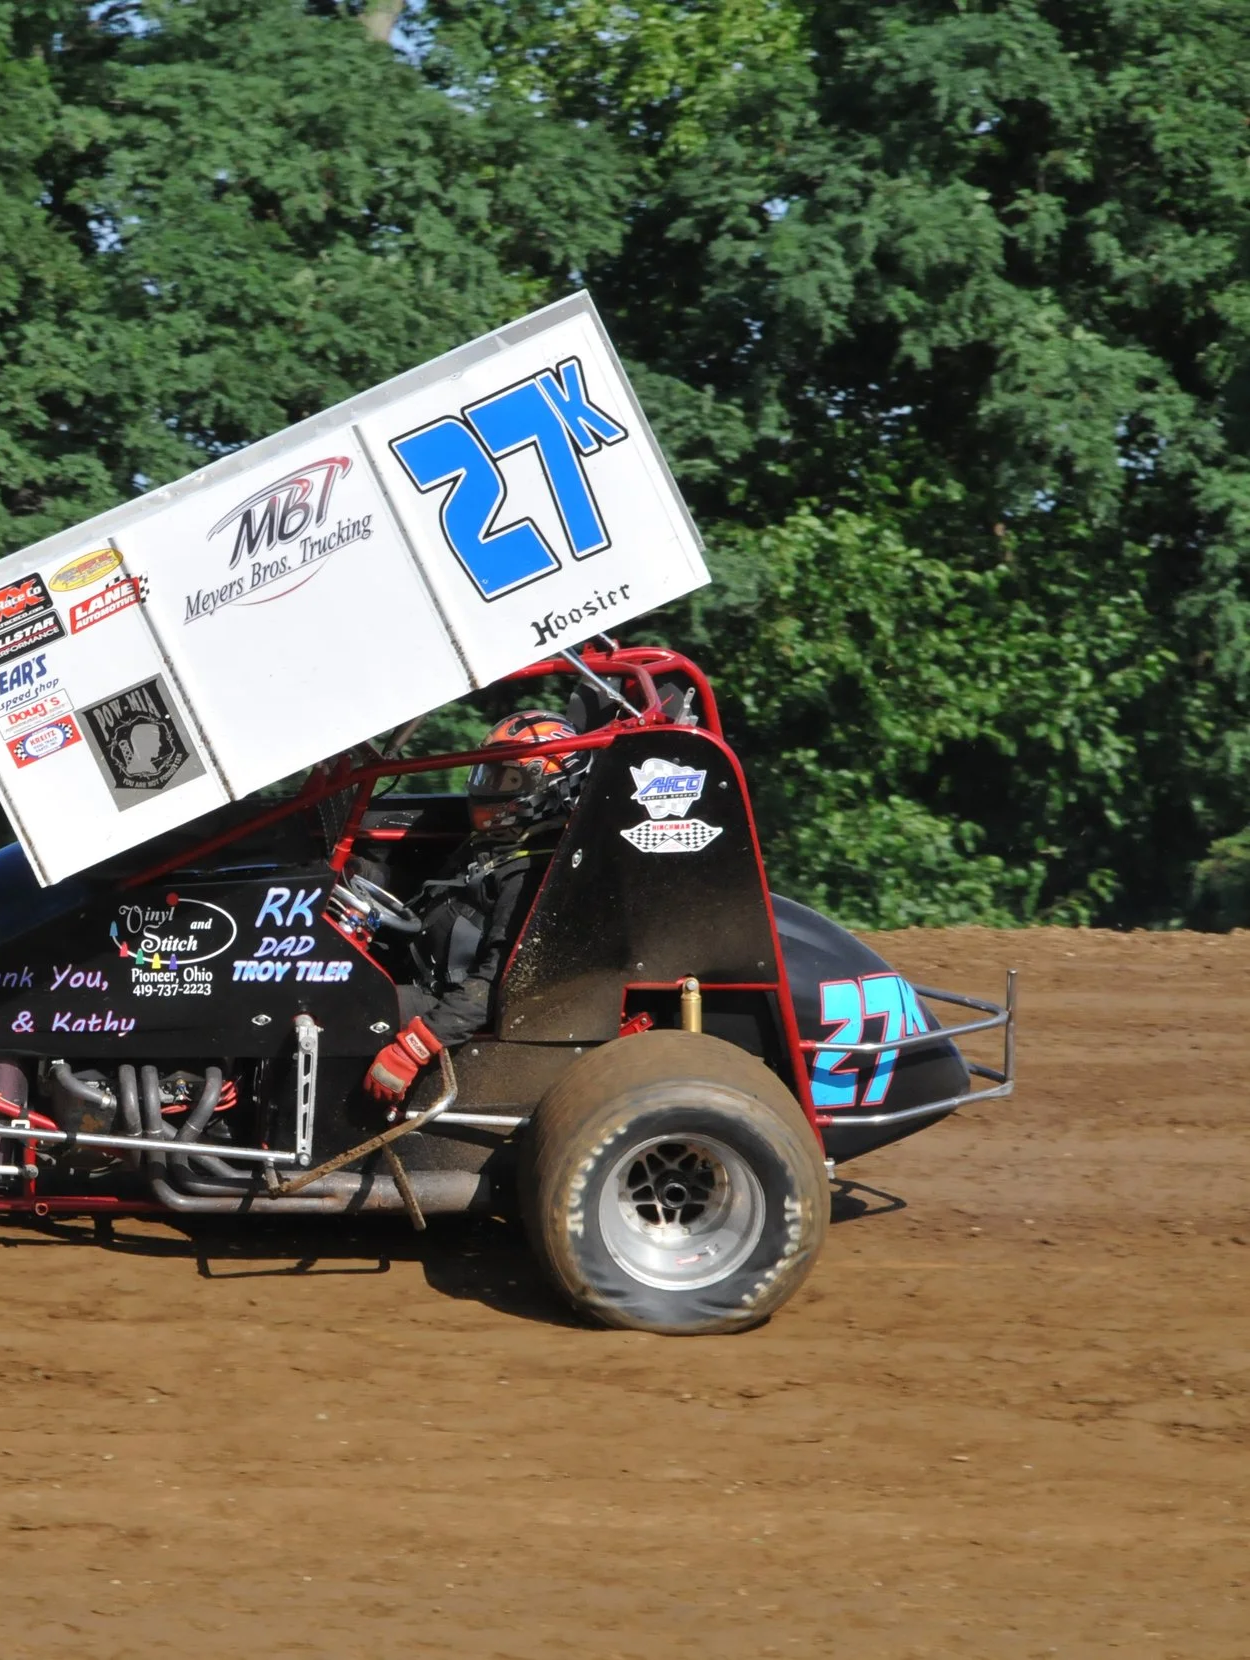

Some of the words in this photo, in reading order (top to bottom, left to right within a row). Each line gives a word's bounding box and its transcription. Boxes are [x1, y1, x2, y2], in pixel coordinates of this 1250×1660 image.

[388, 355, 629, 603] 27K
[229, 456, 353, 569] MBT
[184, 576, 244, 621] Meyers
[250, 555, 292, 588] Bros.
[300, 514, 372, 563] Trucking
[26, 586, 42, 597] Co
[75, 581, 136, 621] LANE
[76, 595, 137, 629] AUTOMOTIVE
[530, 583, 631, 648] Hoosier
[0, 689, 31, 711] speed
[34, 678, 59, 698] shop
[7, 697, 60, 724] Doug's
[118, 904, 175, 934] Vinyl
[190, 918, 213, 930] and
[254, 886, 322, 928] RK
[141, 925, 198, 952] Stitch
[253, 935, 315, 957] DAD
[50, 964, 109, 991] You,
[131, 967, 179, 985] Pioneer,
[183, 967, 213, 983] Ohio
[232, 960, 291, 982] TROY
[295, 960, 353, 983] TILER
[132, 983, 212, 997] 419-737-2223
[11, 1010, 35, 1033] &
[51, 1010, 136, 1037] Kathy
